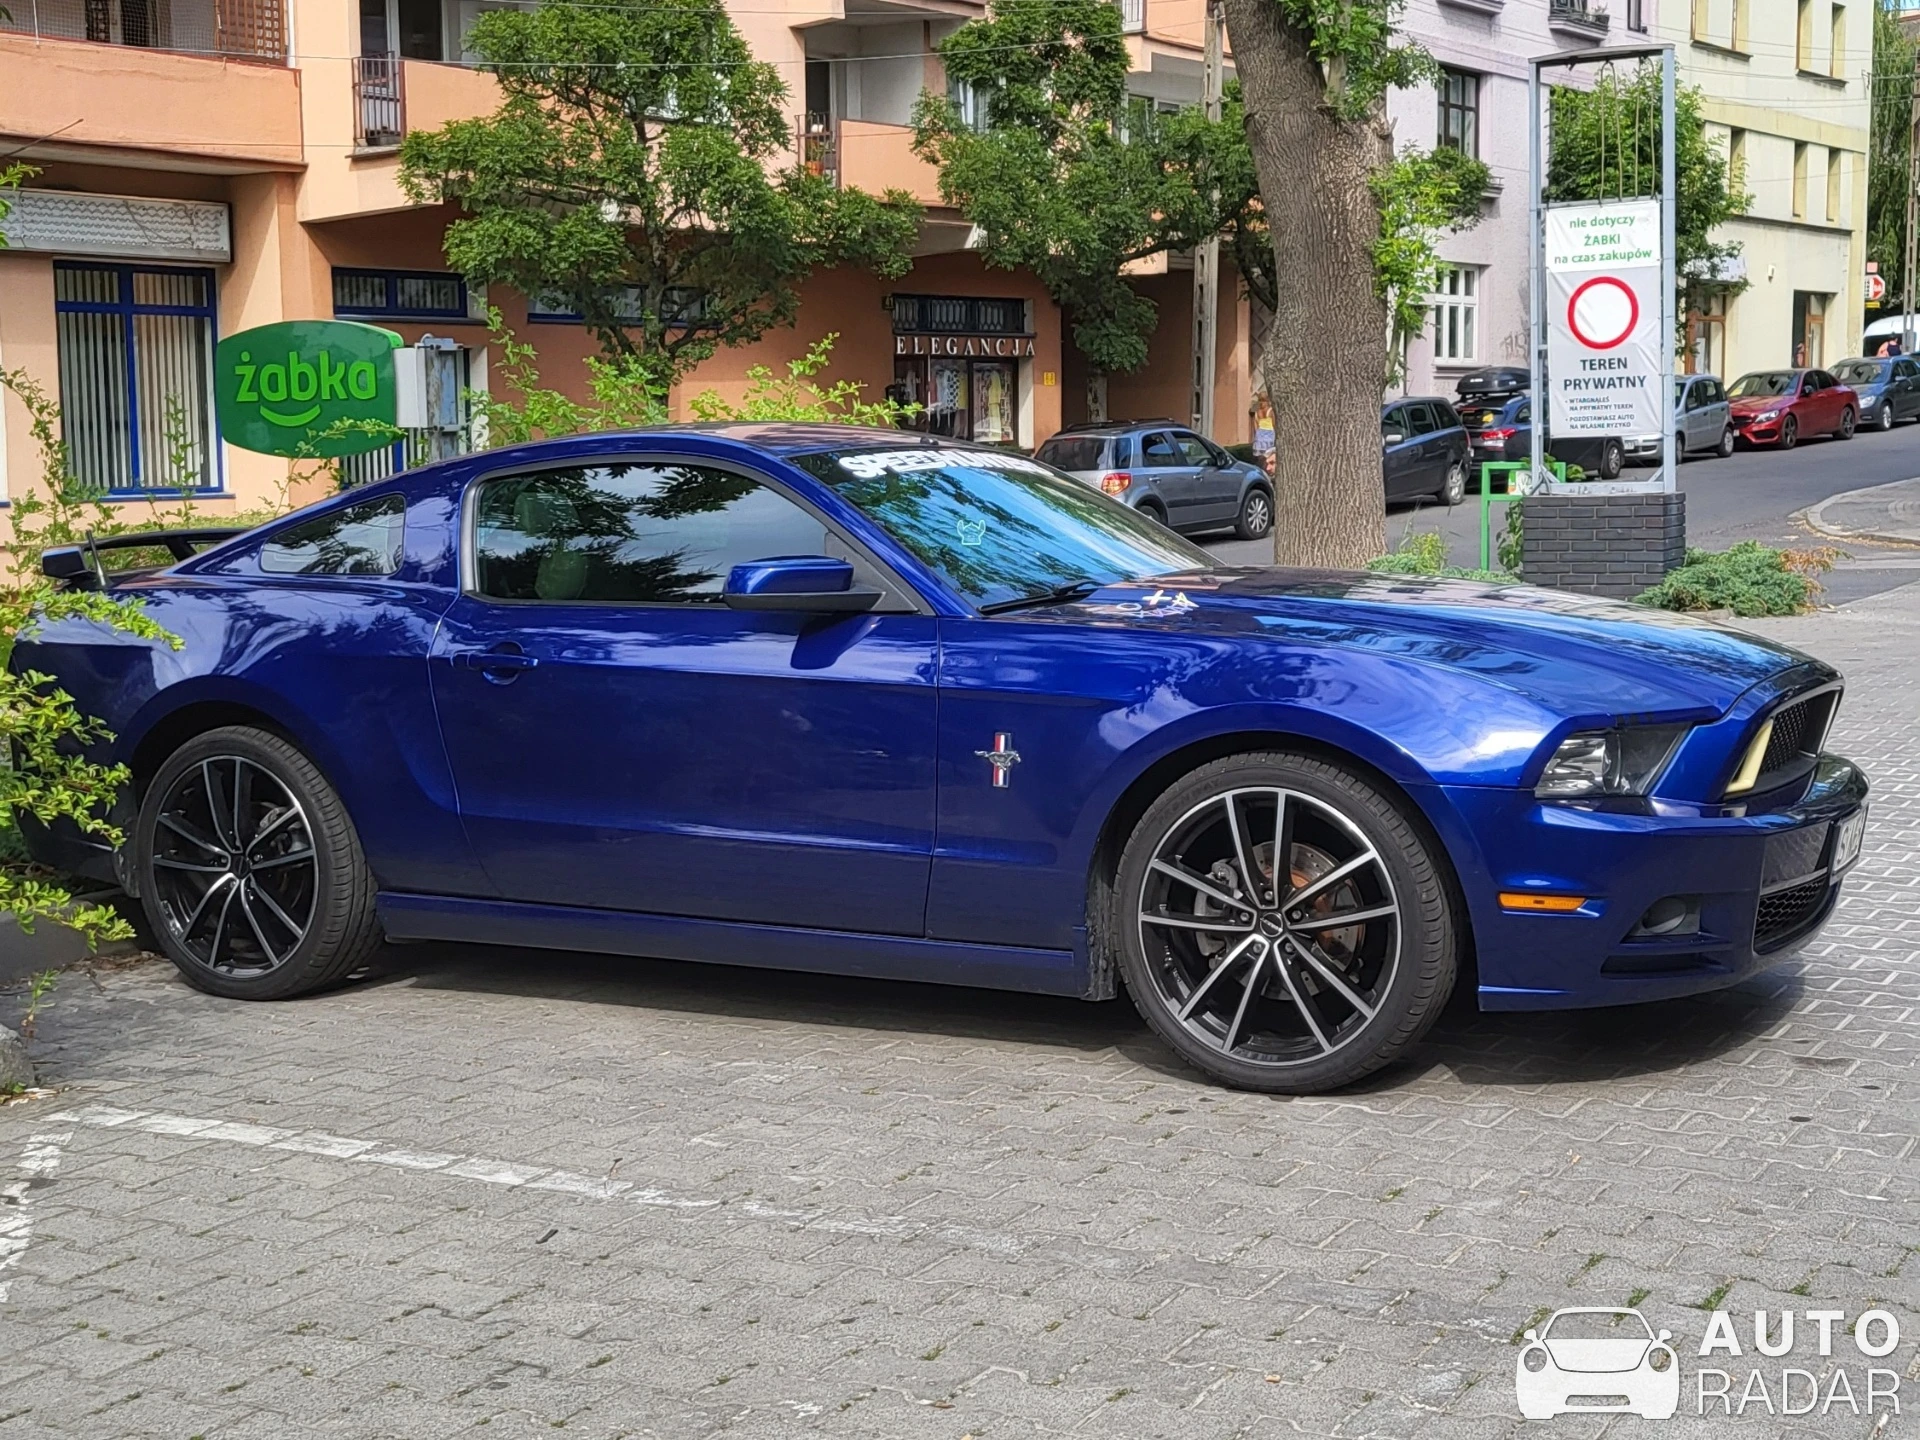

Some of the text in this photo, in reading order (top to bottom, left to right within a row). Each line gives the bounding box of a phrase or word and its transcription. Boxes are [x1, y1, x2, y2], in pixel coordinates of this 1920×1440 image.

[1569, 214, 1636, 229] nie dotyczy
[1583, 233, 1621, 247] ŻABKI
[1554, 248, 1652, 265] na czas zakupów
[896, 335, 1036, 356] ELEGANCJA
[1580, 356, 1628, 371] TEREN
[234, 351, 377, 403] żabka
[1563, 375, 1647, 391] PRYWATNY
[1606, 421, 1632, 429] RYZYKO
